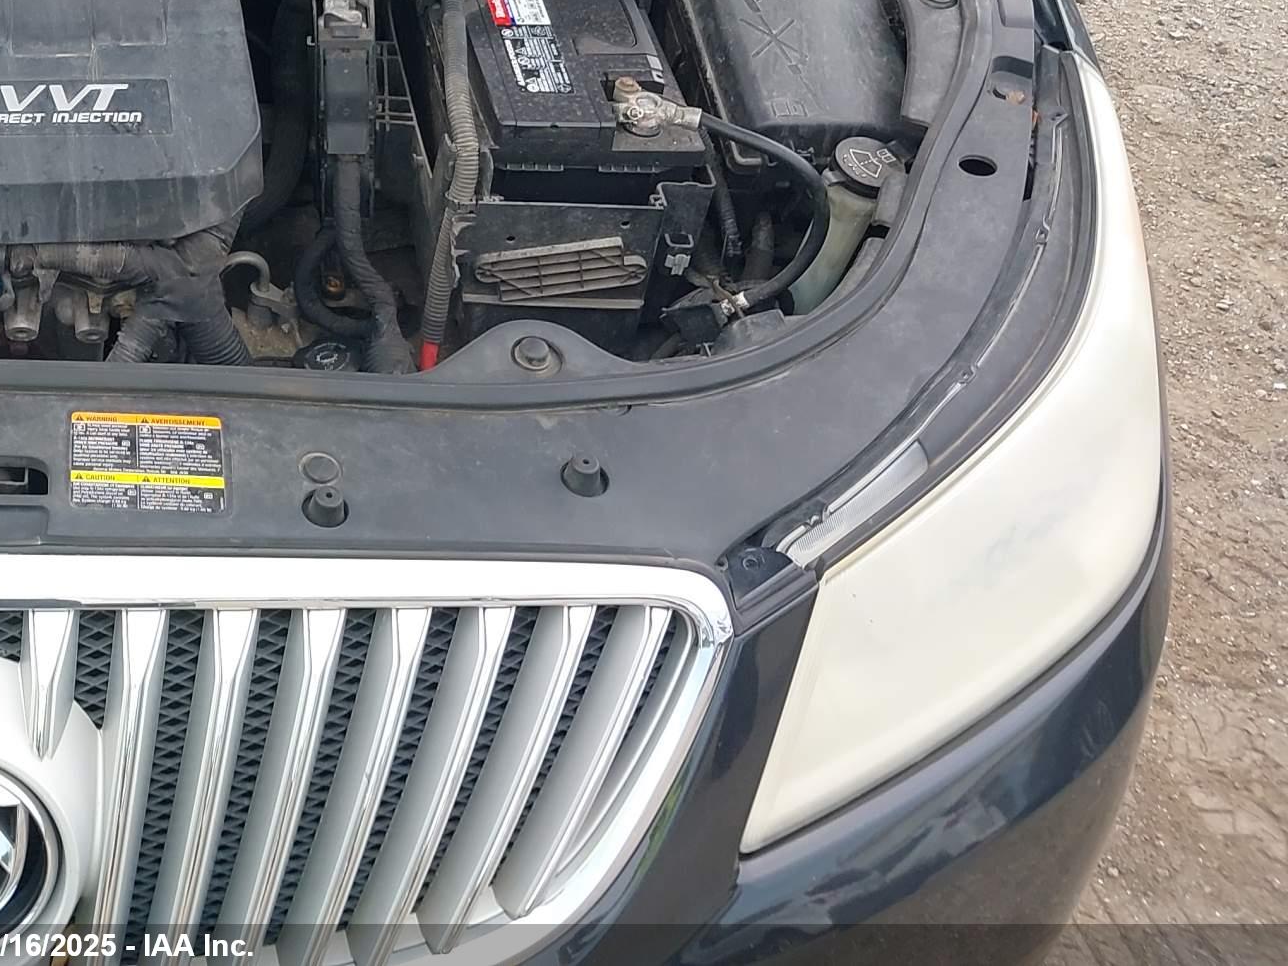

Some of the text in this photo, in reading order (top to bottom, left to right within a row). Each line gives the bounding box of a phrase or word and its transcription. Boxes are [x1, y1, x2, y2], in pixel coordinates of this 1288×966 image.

[0, 84, 129, 112] VVT
[52, 112, 142, 124] INJECTION
[151, 418, 205, 426] AVERTISSEMENT
